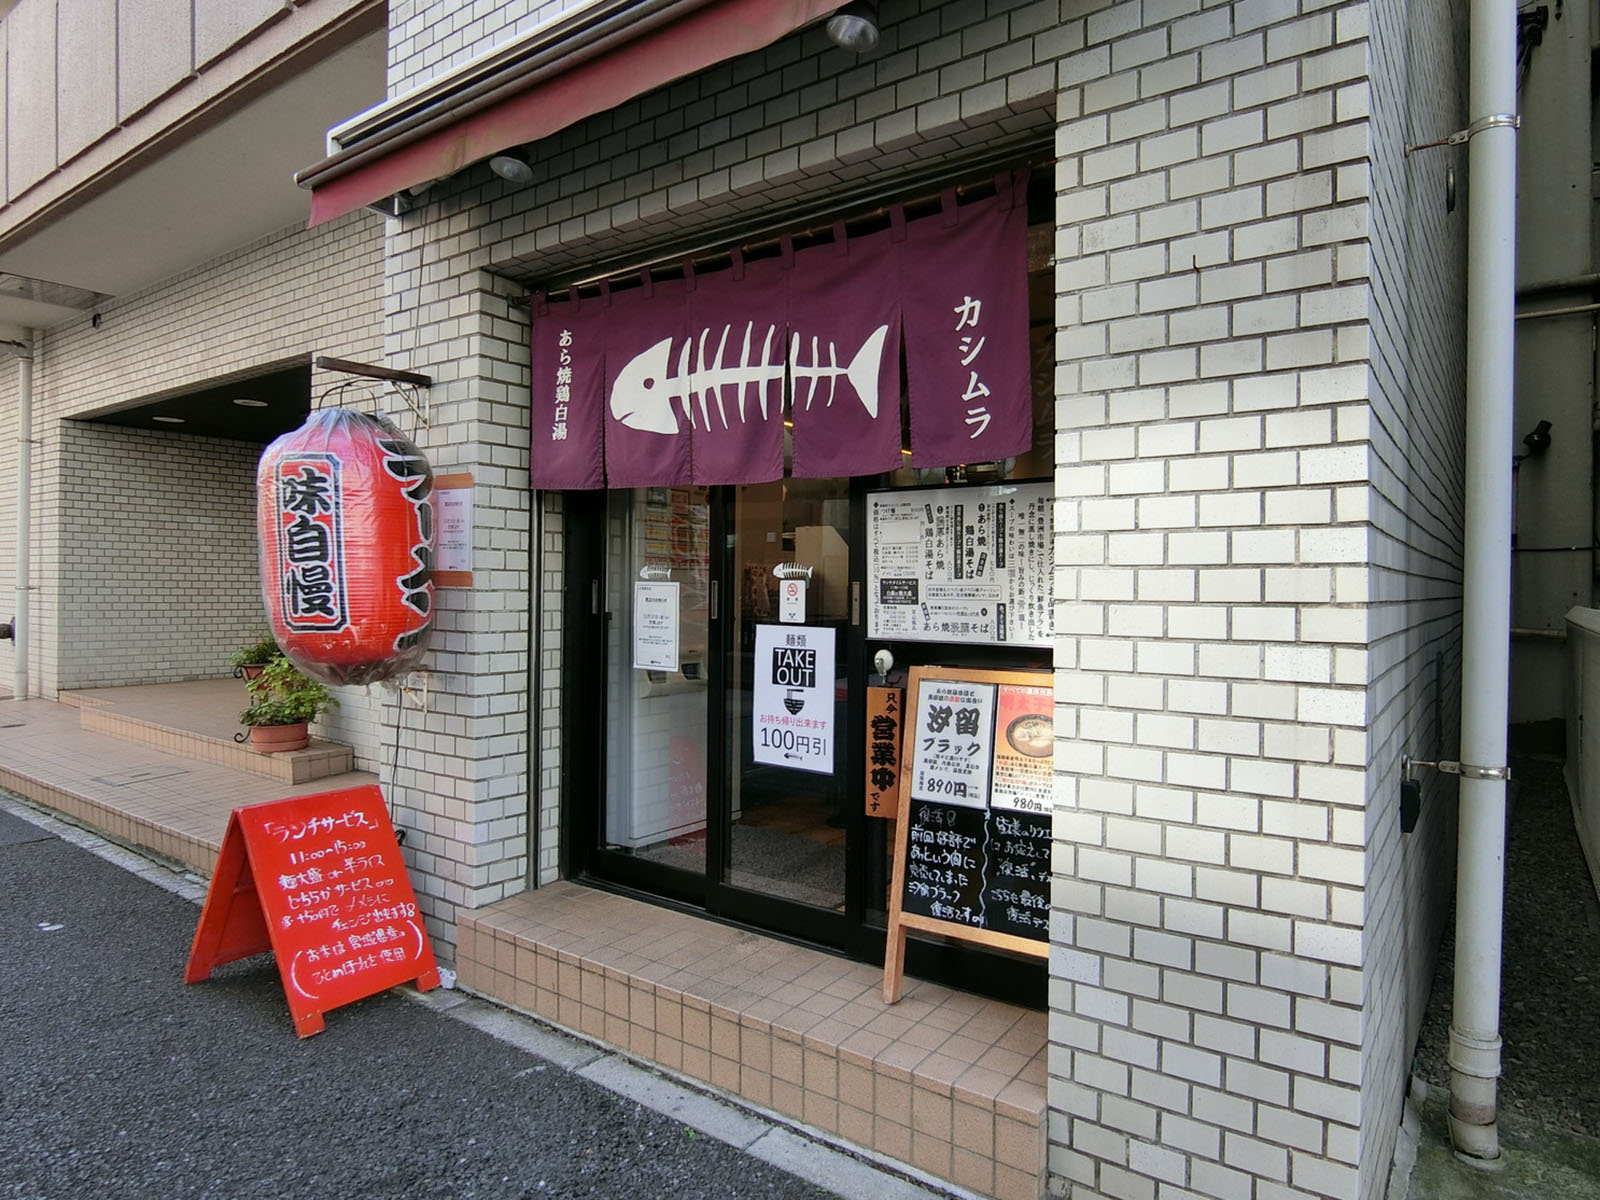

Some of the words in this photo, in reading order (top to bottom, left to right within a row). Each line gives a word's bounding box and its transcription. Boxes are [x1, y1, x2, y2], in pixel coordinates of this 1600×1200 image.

[953, 295, 992, 440] カシムラ
[551, 329, 573, 441] あら焼鶏白湯
[281, 465, 336, 619] 味自慢
[785, 634, 807, 647] 麺類
[774, 649, 815, 669] TAKE
[776, 667, 814, 687] OUT
[885, 691, 898, 714] 只今
[759, 713, 828, 729] お持ち帰り出来ます
[926, 703, 981, 738] 汐留
[760, 727, 827, 756] 100円引
[922, 737, 982, 757] ブラック
[870, 714, 899, 792] 営業中
[926, 778, 968, 799] 890円
[869, 792, 881, 813] です
[1012, 796, 1043, 811] 980円
[264, 811, 379, 842] 「ランチサービス」
